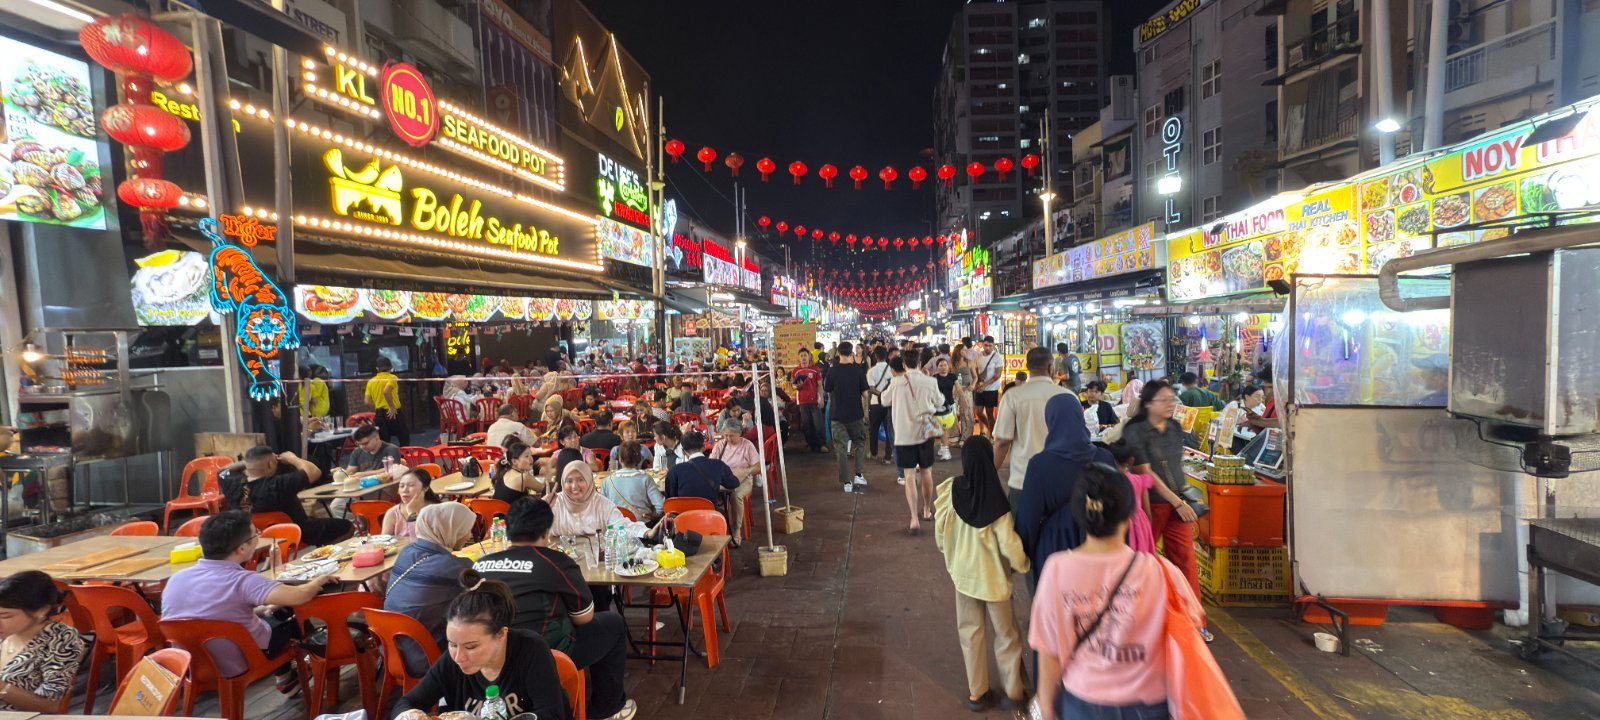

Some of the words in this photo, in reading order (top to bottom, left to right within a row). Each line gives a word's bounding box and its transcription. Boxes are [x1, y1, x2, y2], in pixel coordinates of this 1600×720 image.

[295, 9, 341, 44] STREET
[335, 64, 375, 105] KL
[391, 83, 430, 125] NO.1
[443, 115, 520, 164] SEAFOOD
[521, 151, 547, 176] POT
[1466, 135, 1523, 178] NOY
[410, 187, 484, 239] Boleh
[485, 216, 538, 252] Seafood
[538, 229, 559, 255] Pot
[1288, 219, 1307, 232] THAI
[1310, 210, 1349, 227] KITCHEN
[1301, 199, 1331, 217] REAL
[220, 214, 277, 247] Tiger
[1225, 219, 1249, 241] THAI
